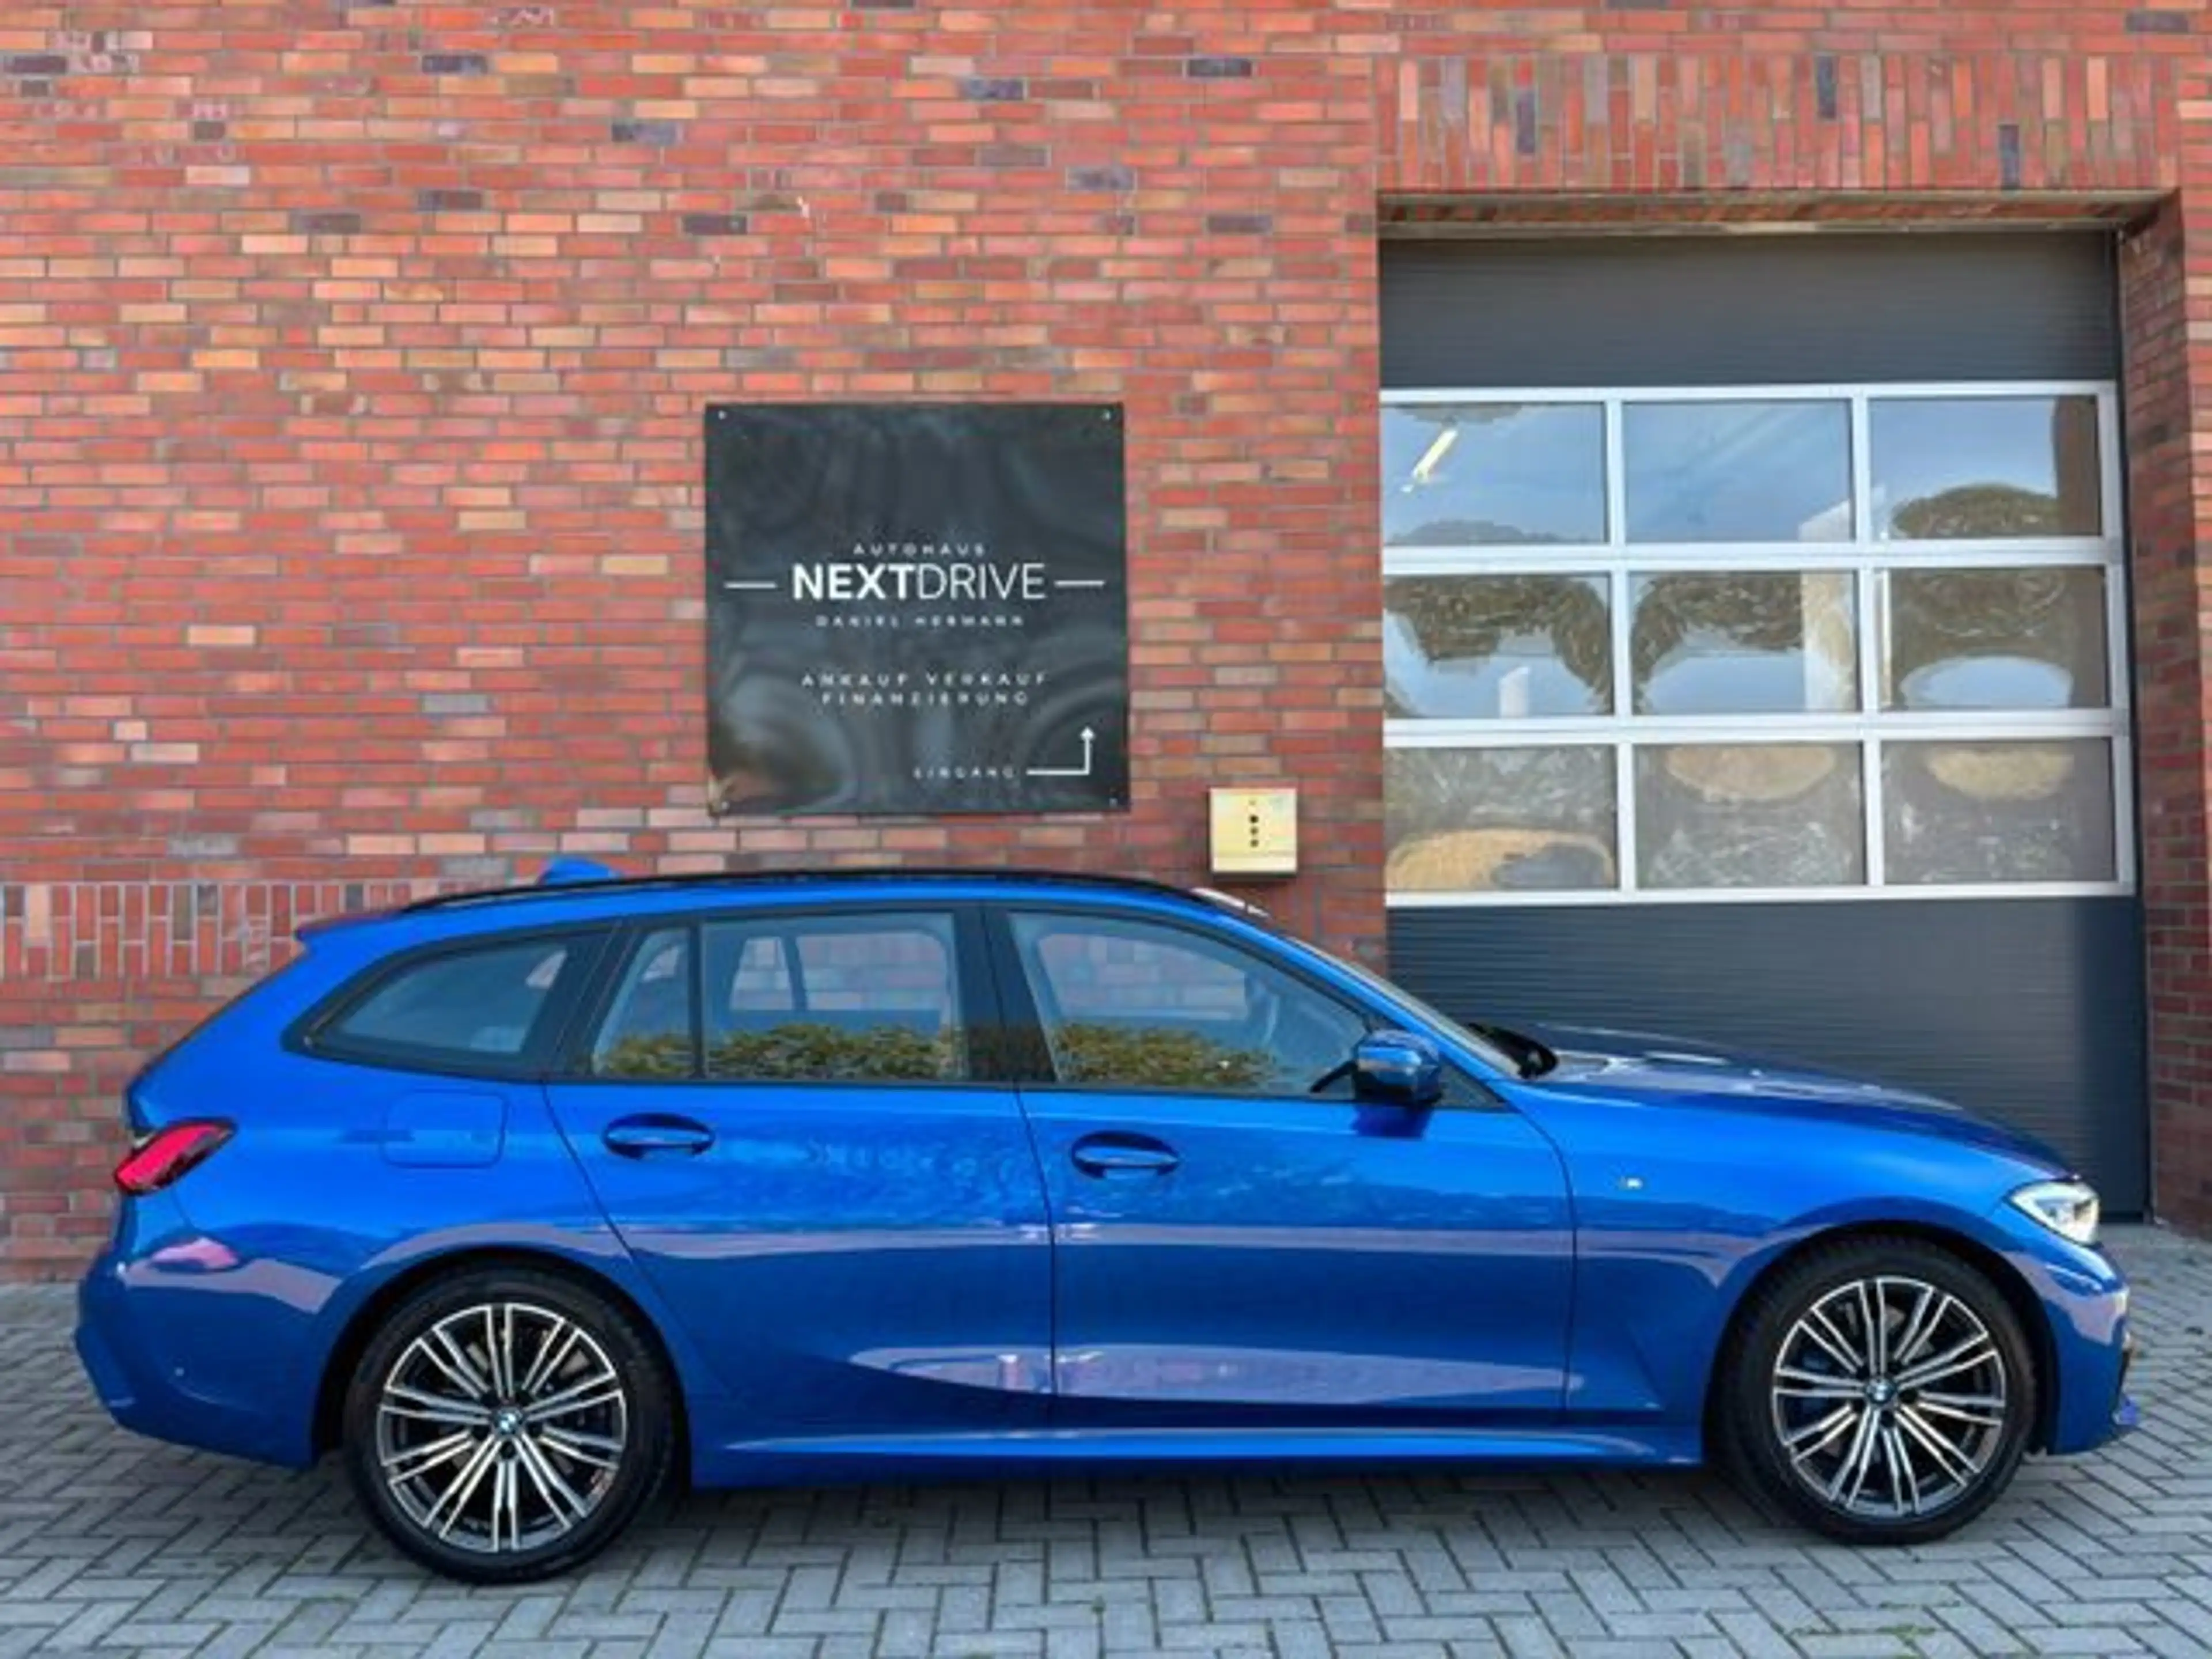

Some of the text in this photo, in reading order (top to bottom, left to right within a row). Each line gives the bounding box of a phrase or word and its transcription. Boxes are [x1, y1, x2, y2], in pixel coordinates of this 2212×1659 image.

[853, 543, 986, 556] AUTOHAUS
[792, 562, 1047, 600] NEXTDRIVE
[801, 672, 1045, 688] ANKAUF VERKAUF
[821, 691, 1028, 706] FINANZIERUNG
